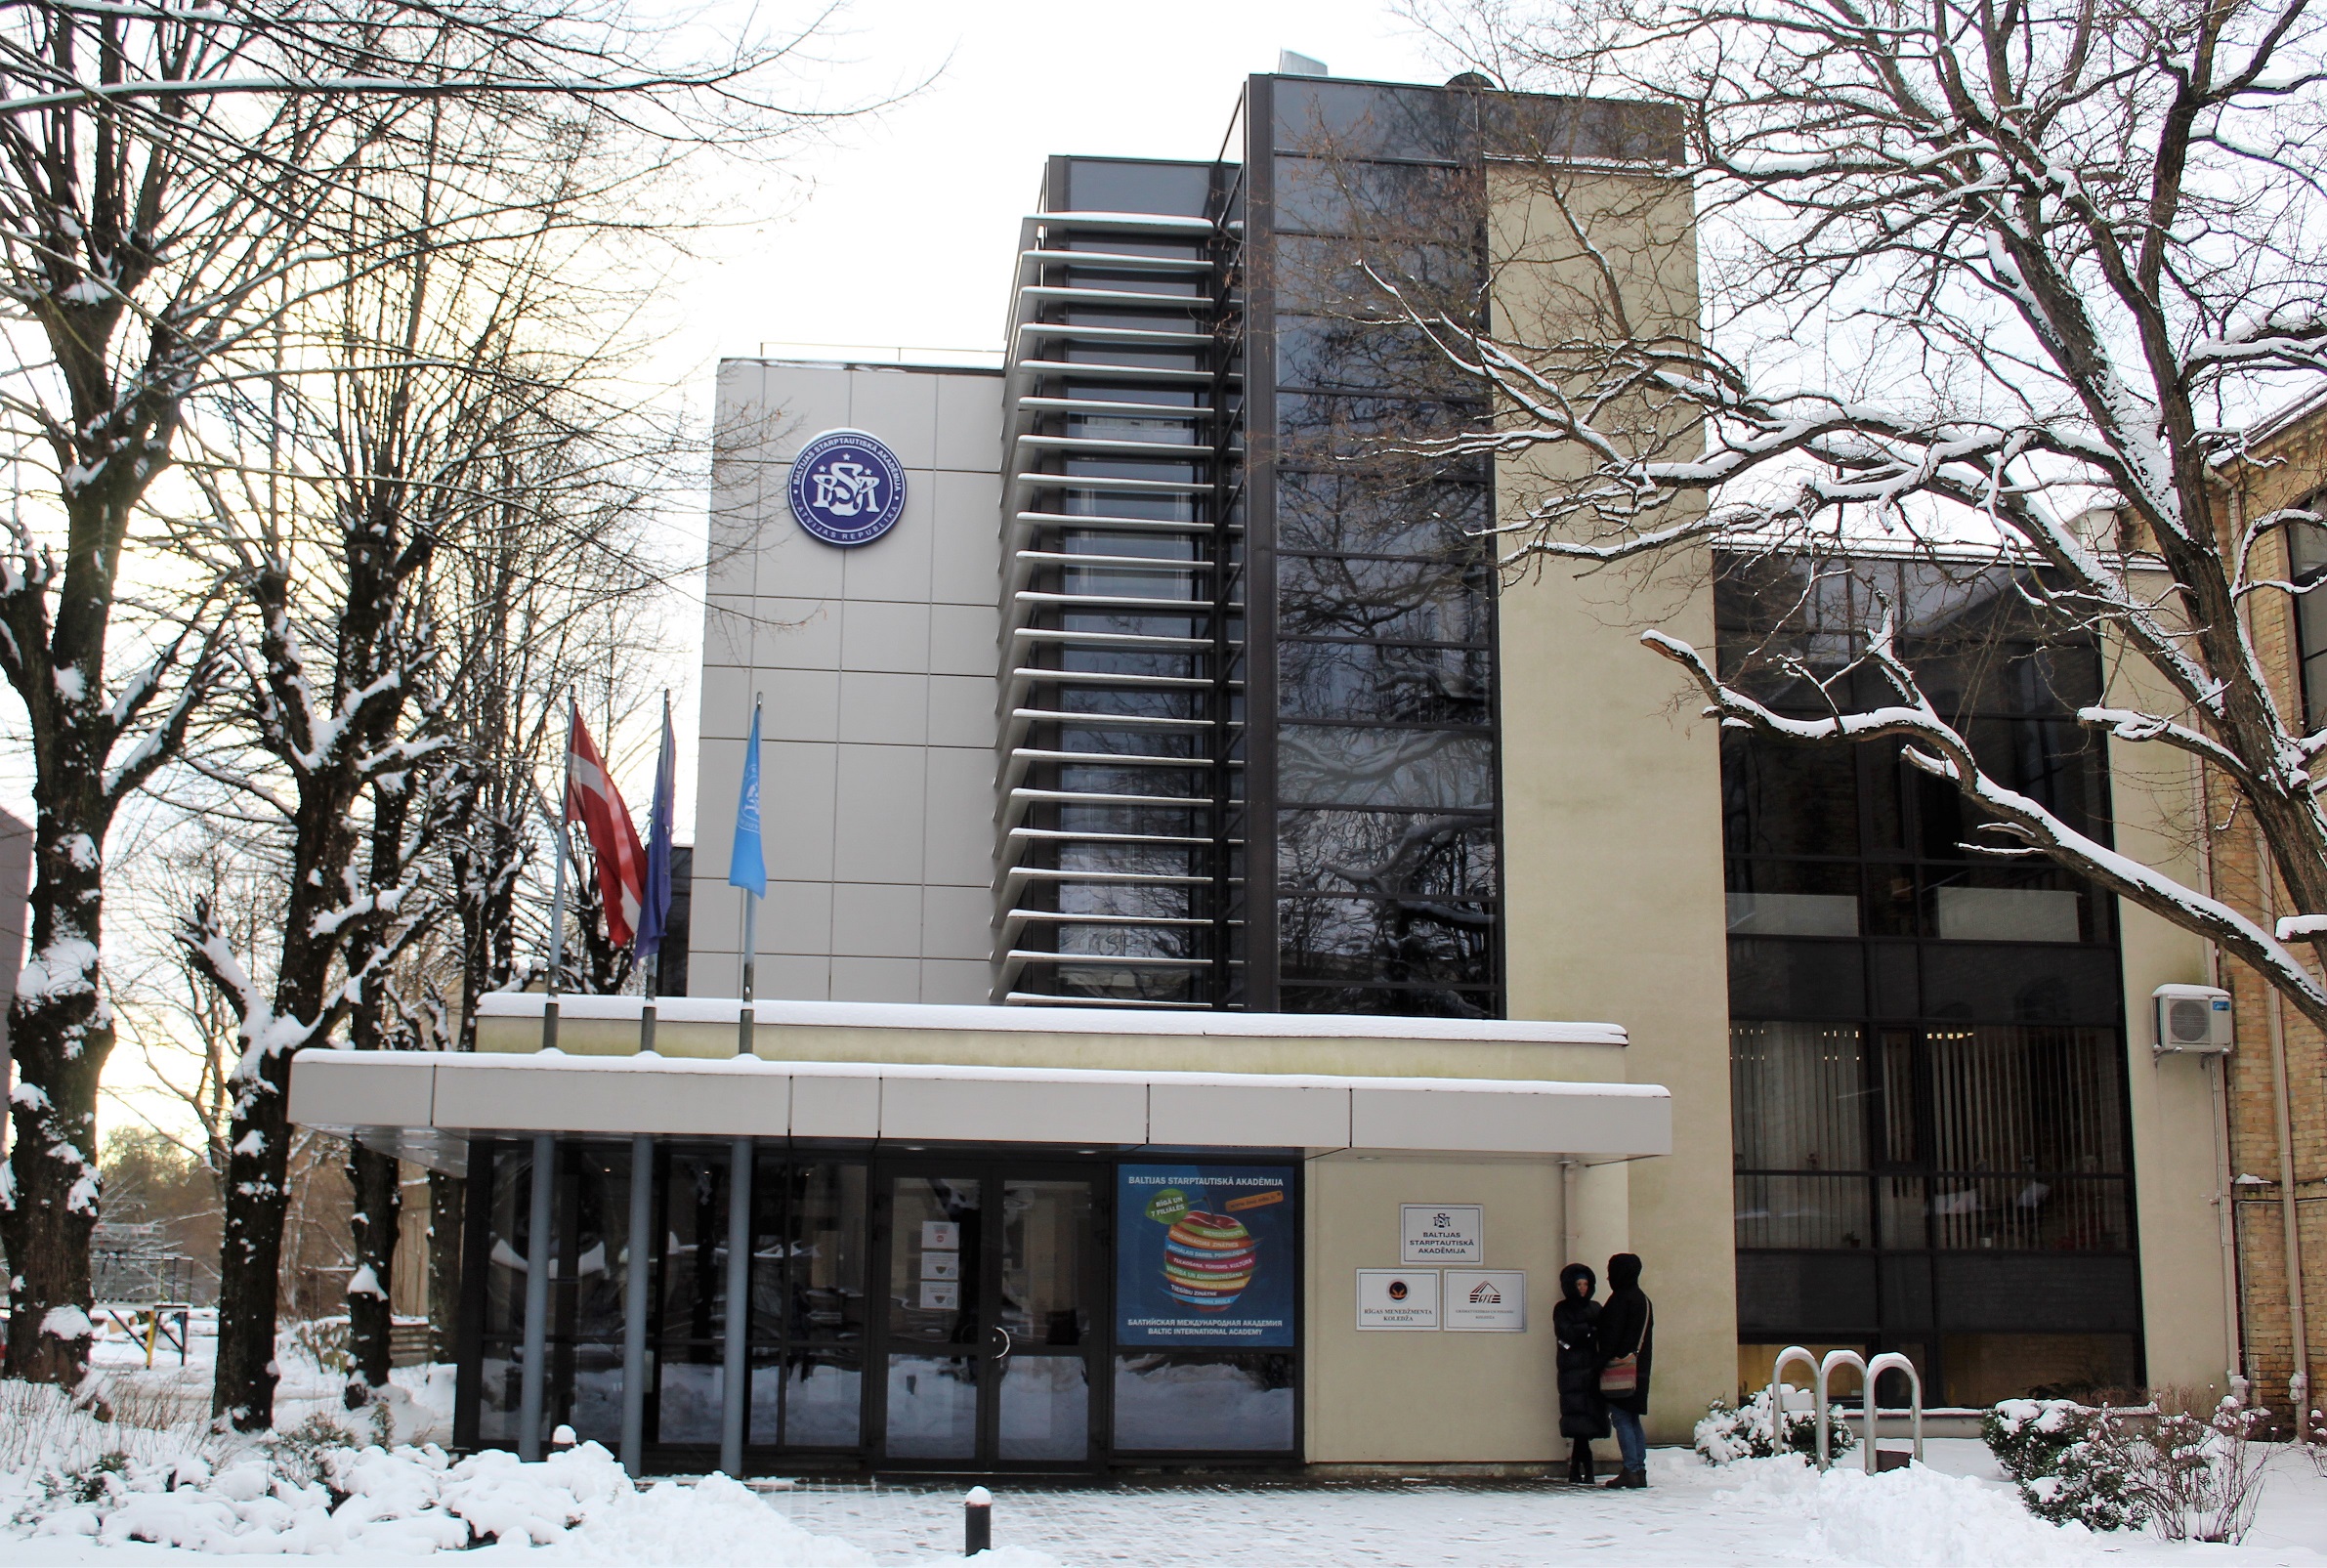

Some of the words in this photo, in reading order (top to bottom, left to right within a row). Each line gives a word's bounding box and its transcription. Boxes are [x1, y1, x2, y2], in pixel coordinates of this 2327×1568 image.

[793, 451, 816, 486] BALTIJAS
[794, 500, 836, 538] LATVIJAS
[841, 506, 898, 539] REPUBLIKA
[1128, 1176, 1166, 1185] BALTIJAS
[1167, 1176, 1234, 1186] STARPTAUTISKĀ
[1235, 1177, 1284, 1186] AKADĒMIJA
[1173, 1196, 1183, 1205] UN
